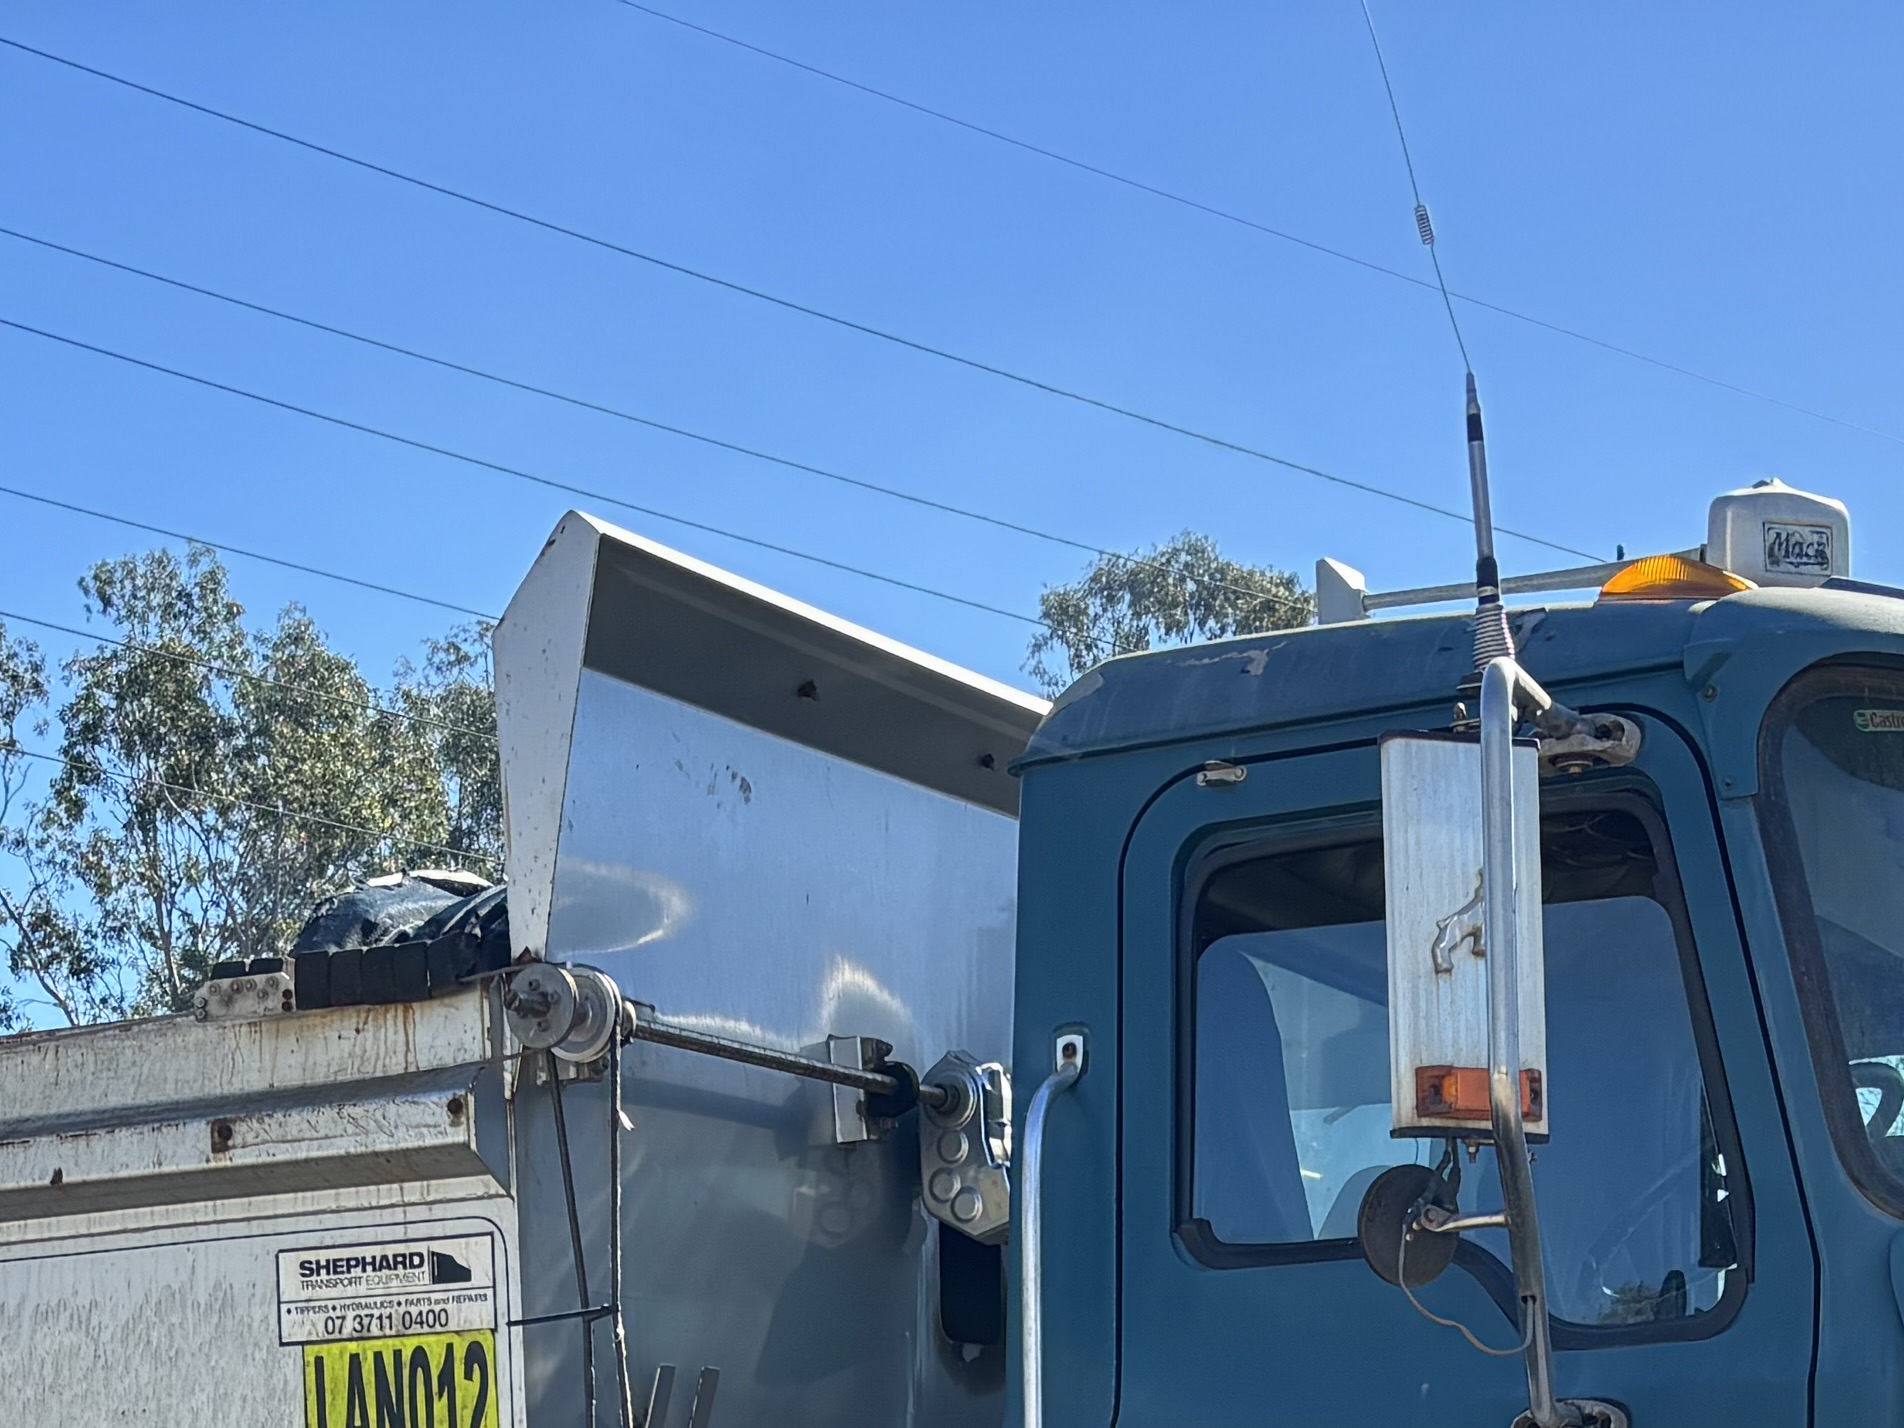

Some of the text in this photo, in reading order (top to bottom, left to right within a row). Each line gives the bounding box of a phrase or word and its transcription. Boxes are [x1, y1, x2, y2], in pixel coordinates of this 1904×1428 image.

[1772, 530, 1830, 562] Mack
[299, 1252, 425, 1278] SHEPHARD
[300, 1270, 427, 1291] TRANSPORT EQUIPMENT
[295, 1304, 330, 1315] TIPPERS
[339, 1300, 395, 1312] HYDRAULICS
[404, 1296, 433, 1308] PARTS
[324, 1308, 449, 1335] 07 3711 0400
